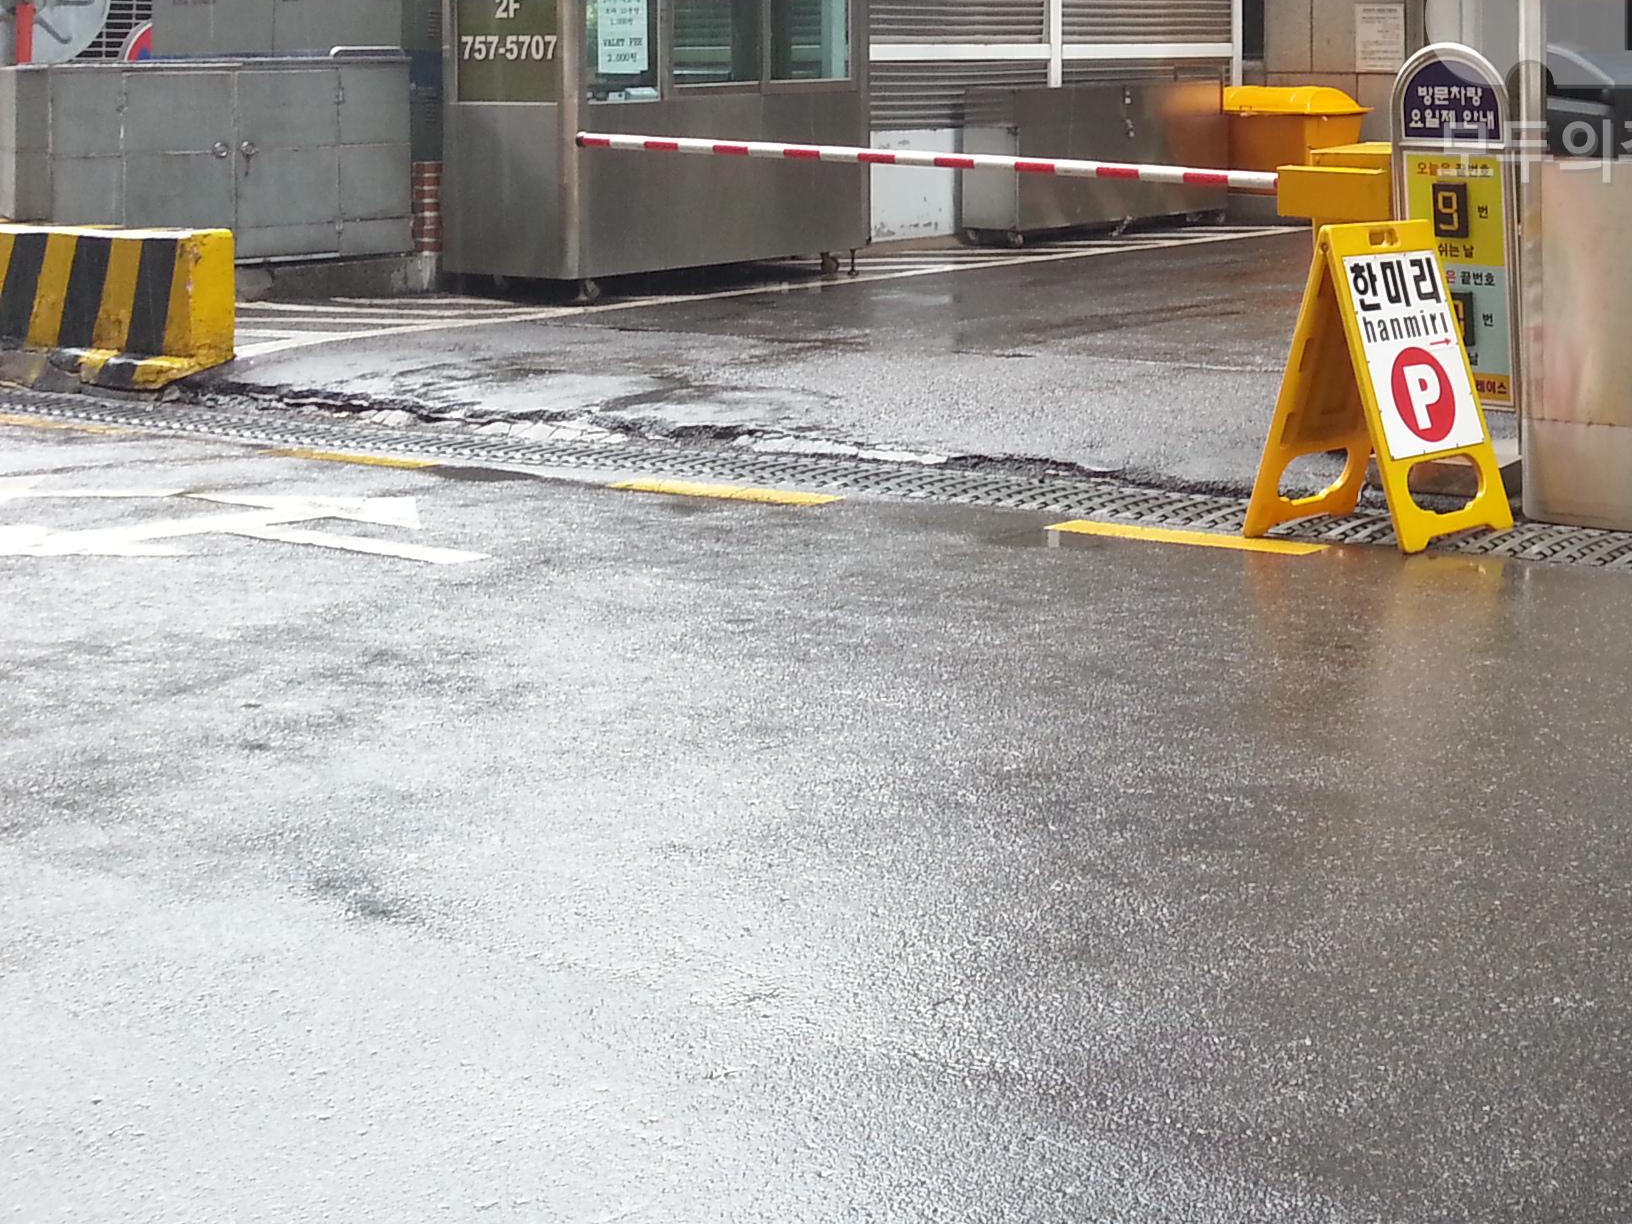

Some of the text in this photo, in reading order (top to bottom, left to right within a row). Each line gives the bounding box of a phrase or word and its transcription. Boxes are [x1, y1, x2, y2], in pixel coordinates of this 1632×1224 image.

[461, 35, 558, 61] 757-5707
[1417, 85, 1483, 107] 방문차량
[1409, 108, 1495, 130] 요일제 안내
[1437, 191, 1459, 231] 9
[1477, 206, 1489, 220] 번
[1463, 244, 1475, 259] 날
[1350, 257, 1442, 312] 한미리
[1362, 310, 1449, 344] hanmiri
[1482, 313, 1493, 328] 번
[1403, 363, 1441, 431] P
